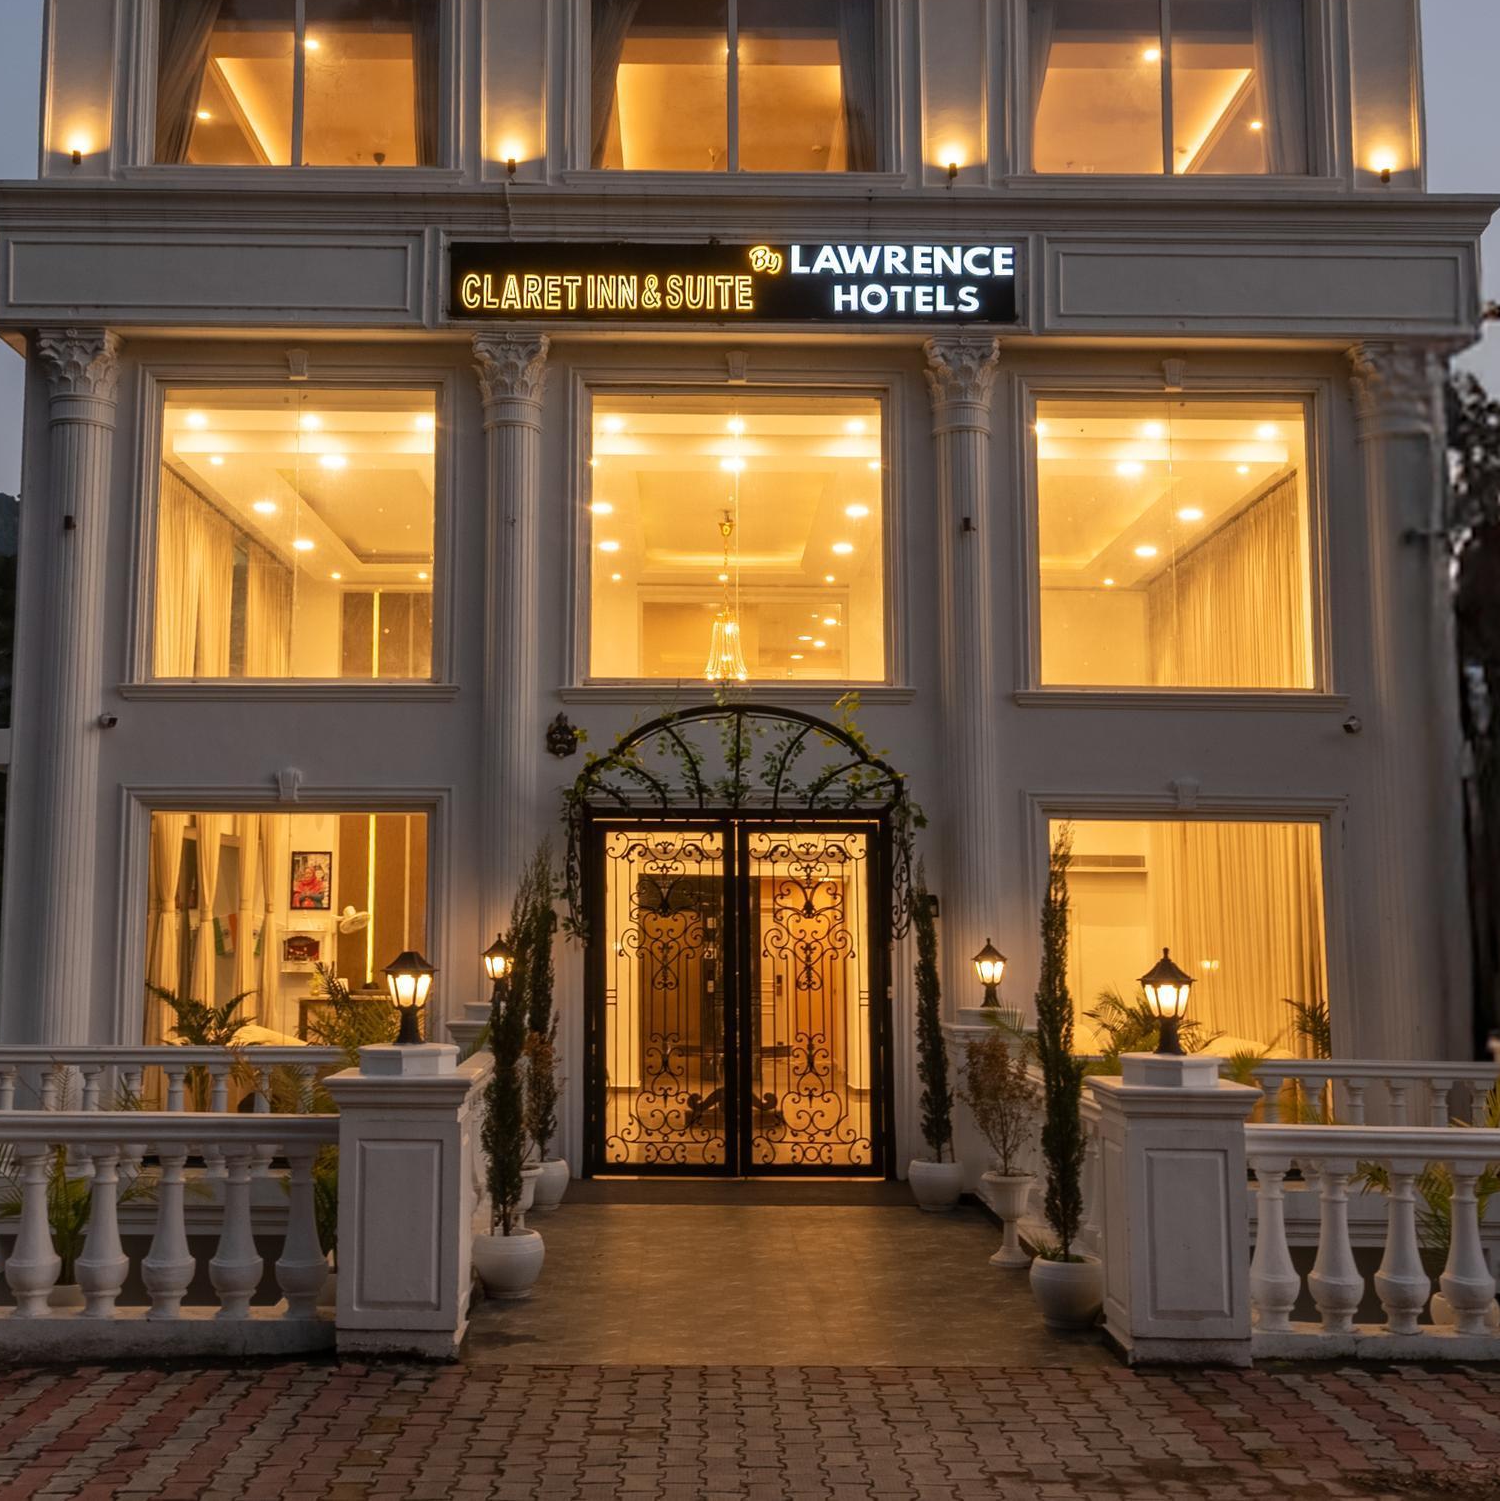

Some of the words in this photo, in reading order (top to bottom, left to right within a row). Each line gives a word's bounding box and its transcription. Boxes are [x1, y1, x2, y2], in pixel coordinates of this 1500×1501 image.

[749, 244, 782, 275] By
[790, 244, 1015, 277] LAWRENCE
[461, 273, 582, 310] CLARET
[587, 274, 638, 309] INN
[641, 273, 662, 309] &
[665, 273, 754, 310] SUITE
[833, 283, 981, 314] HOTELS
